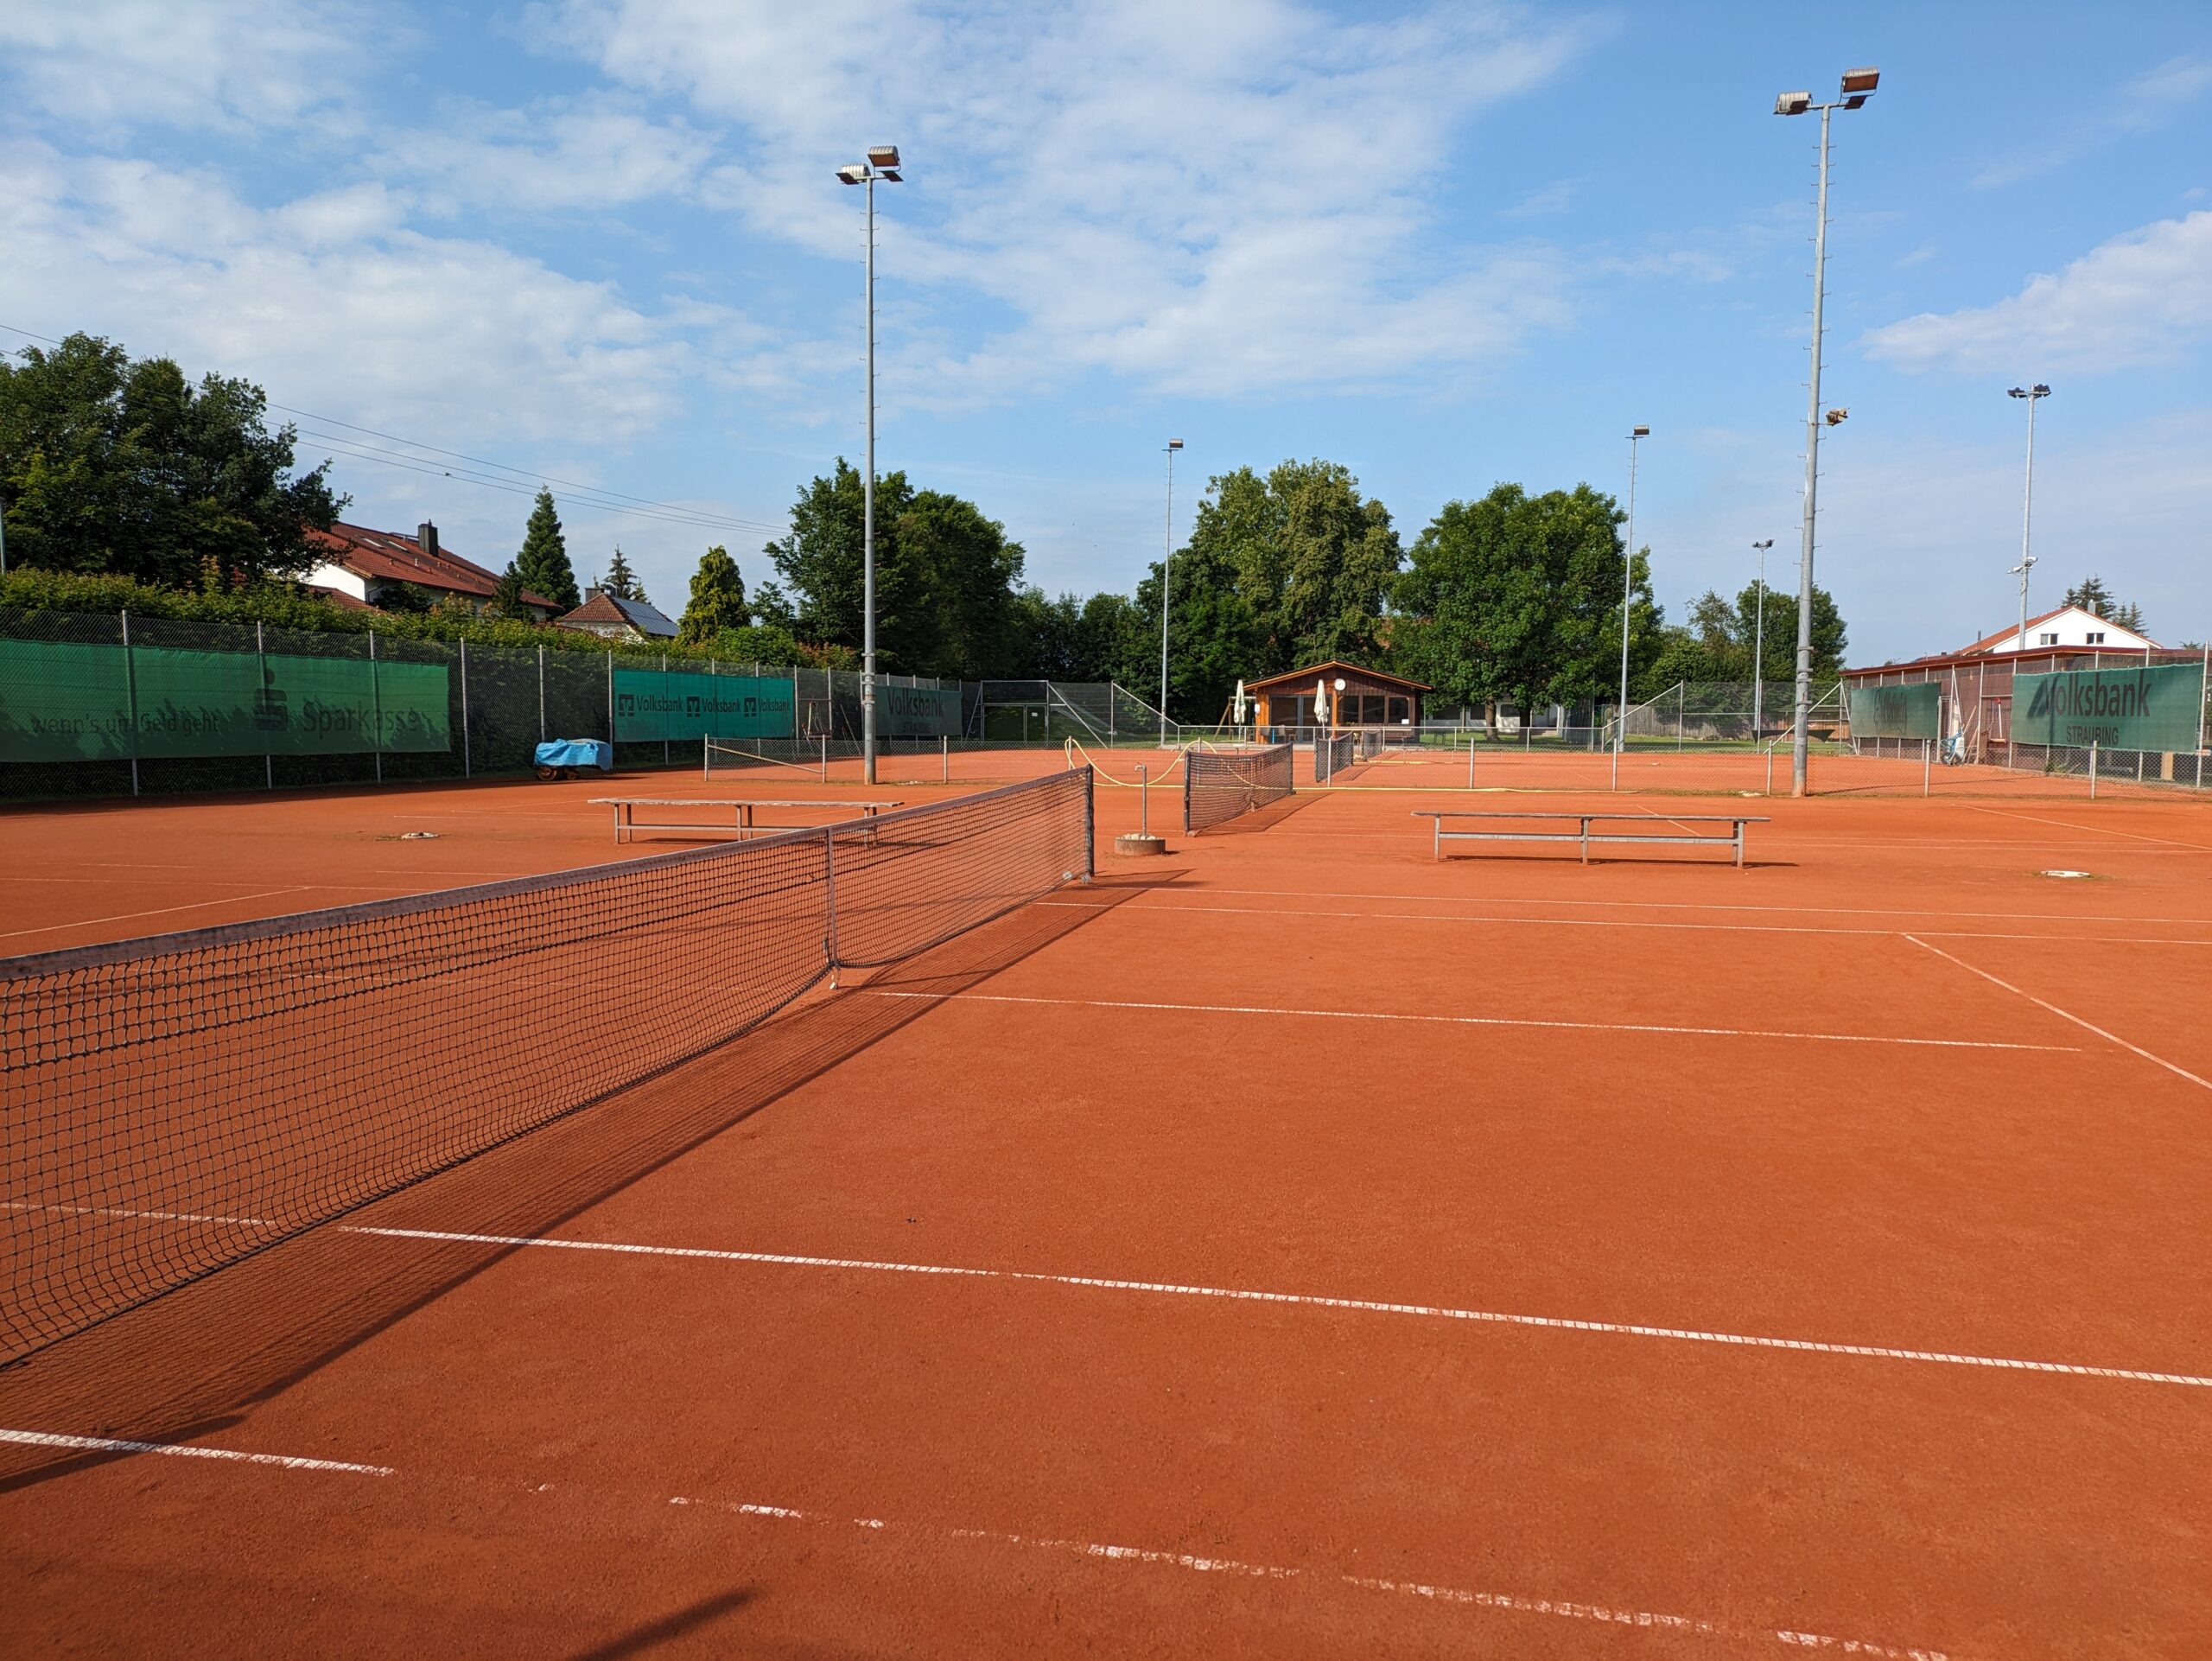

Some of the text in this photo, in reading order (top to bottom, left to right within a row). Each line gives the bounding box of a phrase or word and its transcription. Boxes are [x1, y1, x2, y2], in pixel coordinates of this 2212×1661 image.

[636, 695, 683, 712] Volksbank
[758, 697, 791, 712] Volksbank
[887, 687, 944, 717] Volksbank
[2042, 670, 2152, 717] Volksbank
[702, 697, 741, 713] Volksbank
[32, 714, 99, 734] wenn's
[140, 713, 177, 733] Geld
[182, 714, 219, 736] geht
[303, 701, 418, 739] Sparkasse
[2066, 724, 2120, 746] STRAUBING
